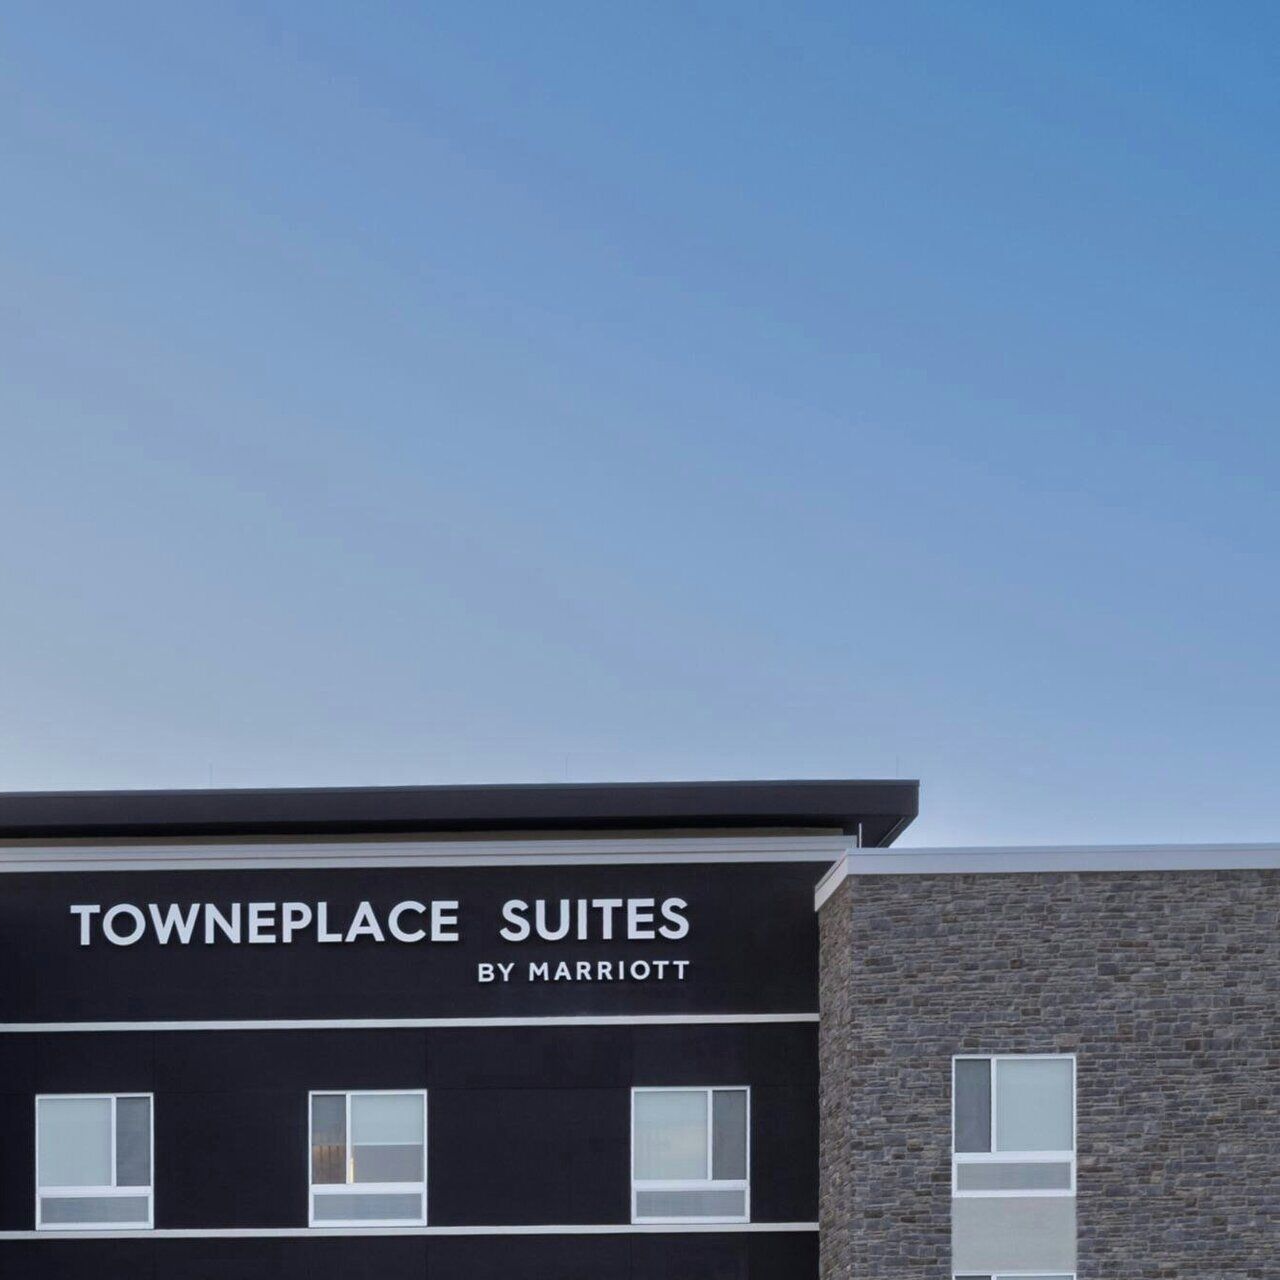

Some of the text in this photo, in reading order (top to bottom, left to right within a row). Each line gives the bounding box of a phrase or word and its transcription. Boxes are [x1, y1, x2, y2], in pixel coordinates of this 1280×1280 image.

[70, 897, 690, 946] TOWNEPLACE SUITES
[478, 959, 690, 983] BY MARRIOTT
